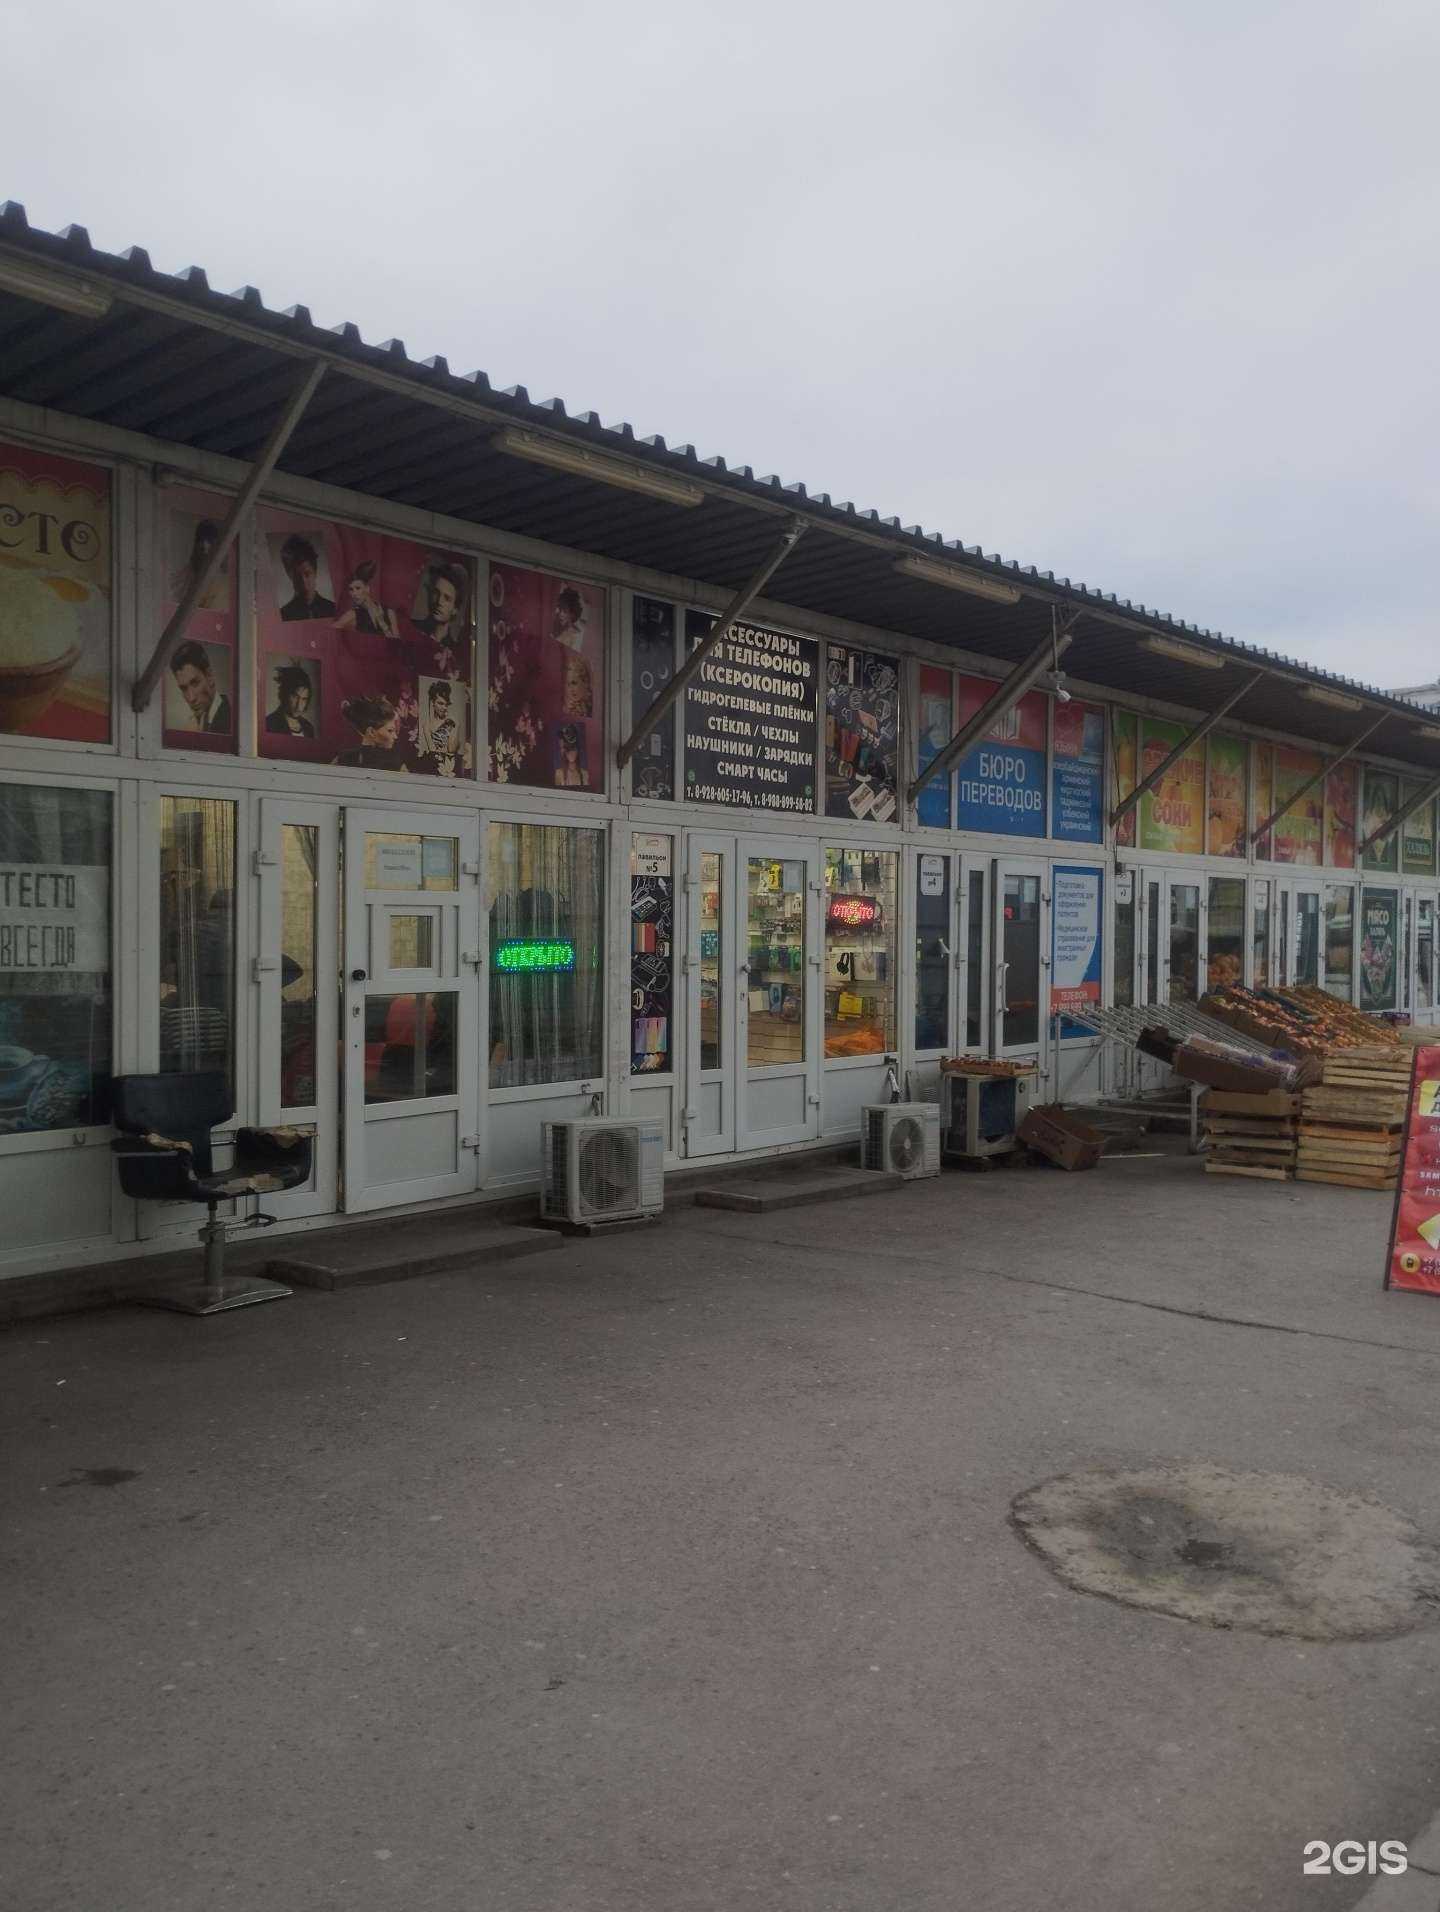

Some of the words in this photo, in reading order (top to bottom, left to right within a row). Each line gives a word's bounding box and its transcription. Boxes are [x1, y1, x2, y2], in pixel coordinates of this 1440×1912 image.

[711, 620, 800, 657] СЕССУАРЫ
[726, 645, 811, 678] ТЕЛЕФОНОВ
[700, 662, 805, 702] (КСЕРОКОПИЯ)
[687, 687, 771, 715] ГИДРОГЕЛЕВЫЕ
[774, 703, 814, 723] ПЛЁНКИ
[708, 715, 751, 736] СТЁКЛА
[762, 725, 799, 744] ЧЕХЛЫ
[687, 734, 753, 757] НАУШНИКИ
[764, 746, 813, 766] ЗАРЯДКИ
[716, 761, 755, 779] СМАРТ
[757, 767, 788, 783] ЧАСЫ
[979, 752, 1026, 784] БЮРО
[961, 780, 1042, 812] ПЕРЕВОДОВ
[0, 871, 77, 909] ТЕСТО
